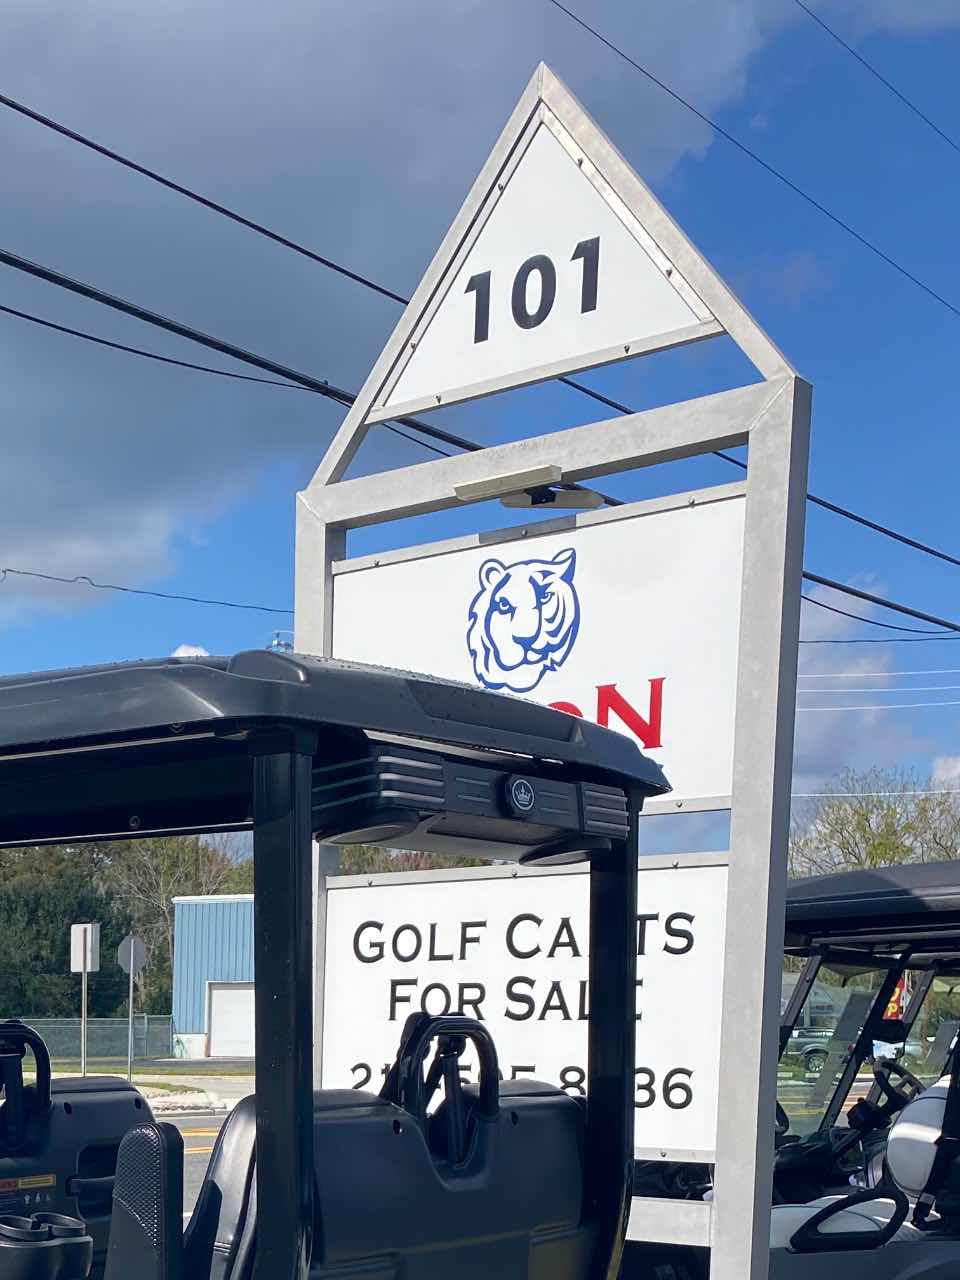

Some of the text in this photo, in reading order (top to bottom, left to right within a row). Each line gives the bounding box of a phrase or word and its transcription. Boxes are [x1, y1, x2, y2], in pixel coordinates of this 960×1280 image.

[464, 236, 600, 344] 101
[353, 912, 695, 963] GOLF CATS
[388, 976, 643, 1021] FOR SAL
